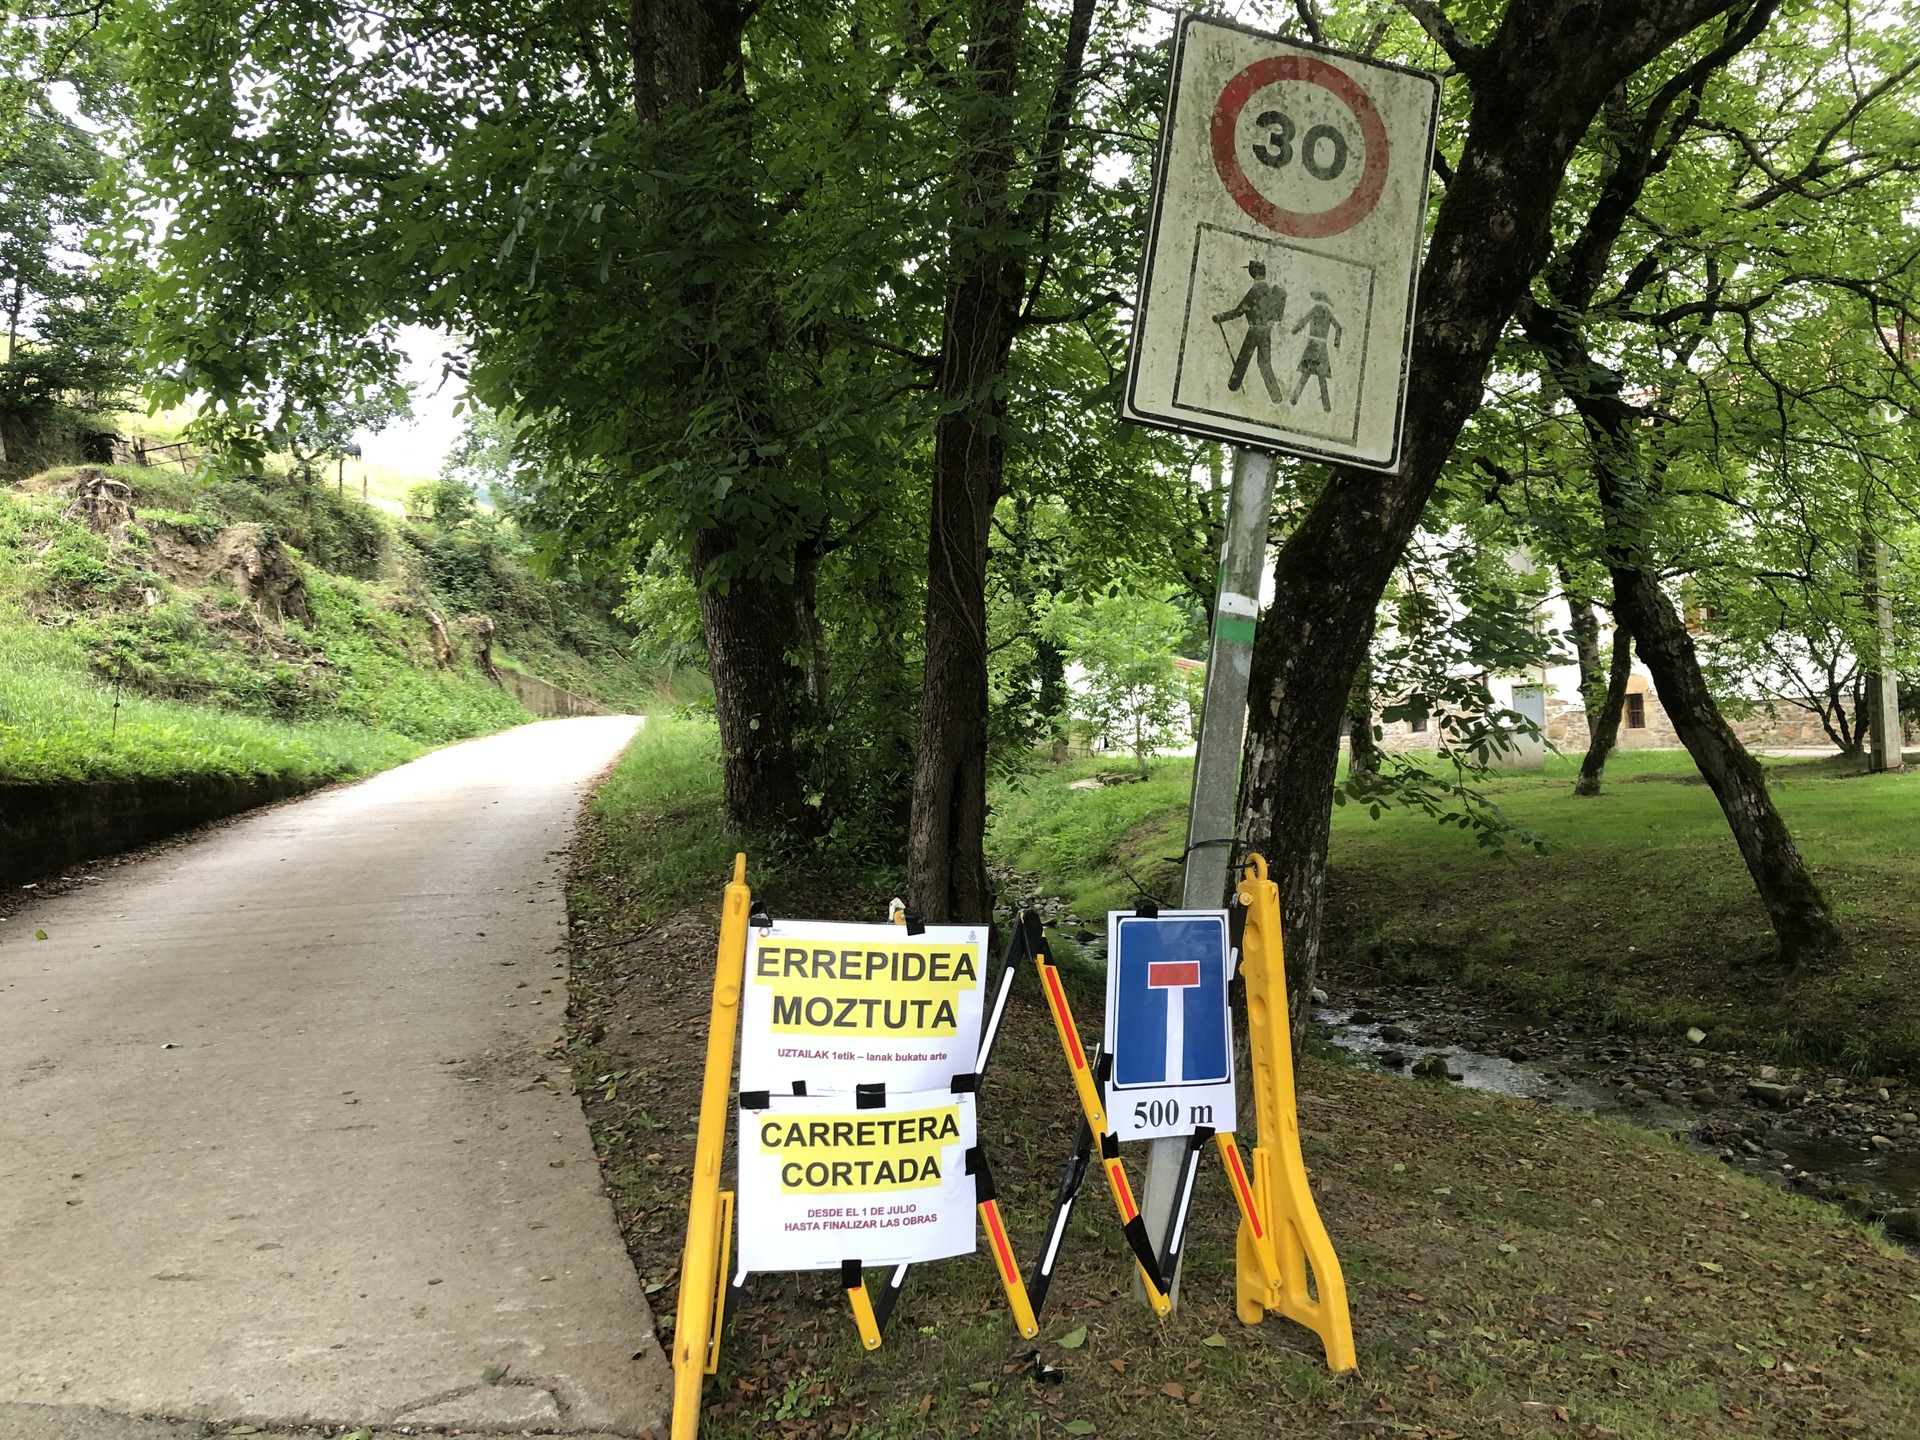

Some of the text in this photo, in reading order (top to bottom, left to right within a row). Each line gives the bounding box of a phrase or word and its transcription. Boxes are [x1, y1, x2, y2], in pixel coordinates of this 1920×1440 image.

[1252, 110, 1348, 181] 30
[757, 947, 977, 982] ERREPIDEA
[773, 995, 957, 1029] MOZTUTA
[777, 1048, 829, 1060] UZTAILAK
[832, 1051, 855, 1061] 1etik
[867, 1052, 893, 1062] lanak
[895, 1052, 928, 1062] bukatu
[930, 1052, 948, 1061] arte
[761, 1113, 960, 1148] CARRETERA
[1133, 1099, 1214, 1129] 500 m
[781, 1155, 942, 1188] CORTADA
[784, 1213, 938, 1232] HASTA FINALIZAR LAS OBRAS
[807, 1204, 917, 1218] DESDE EL 1 DE JULIO
